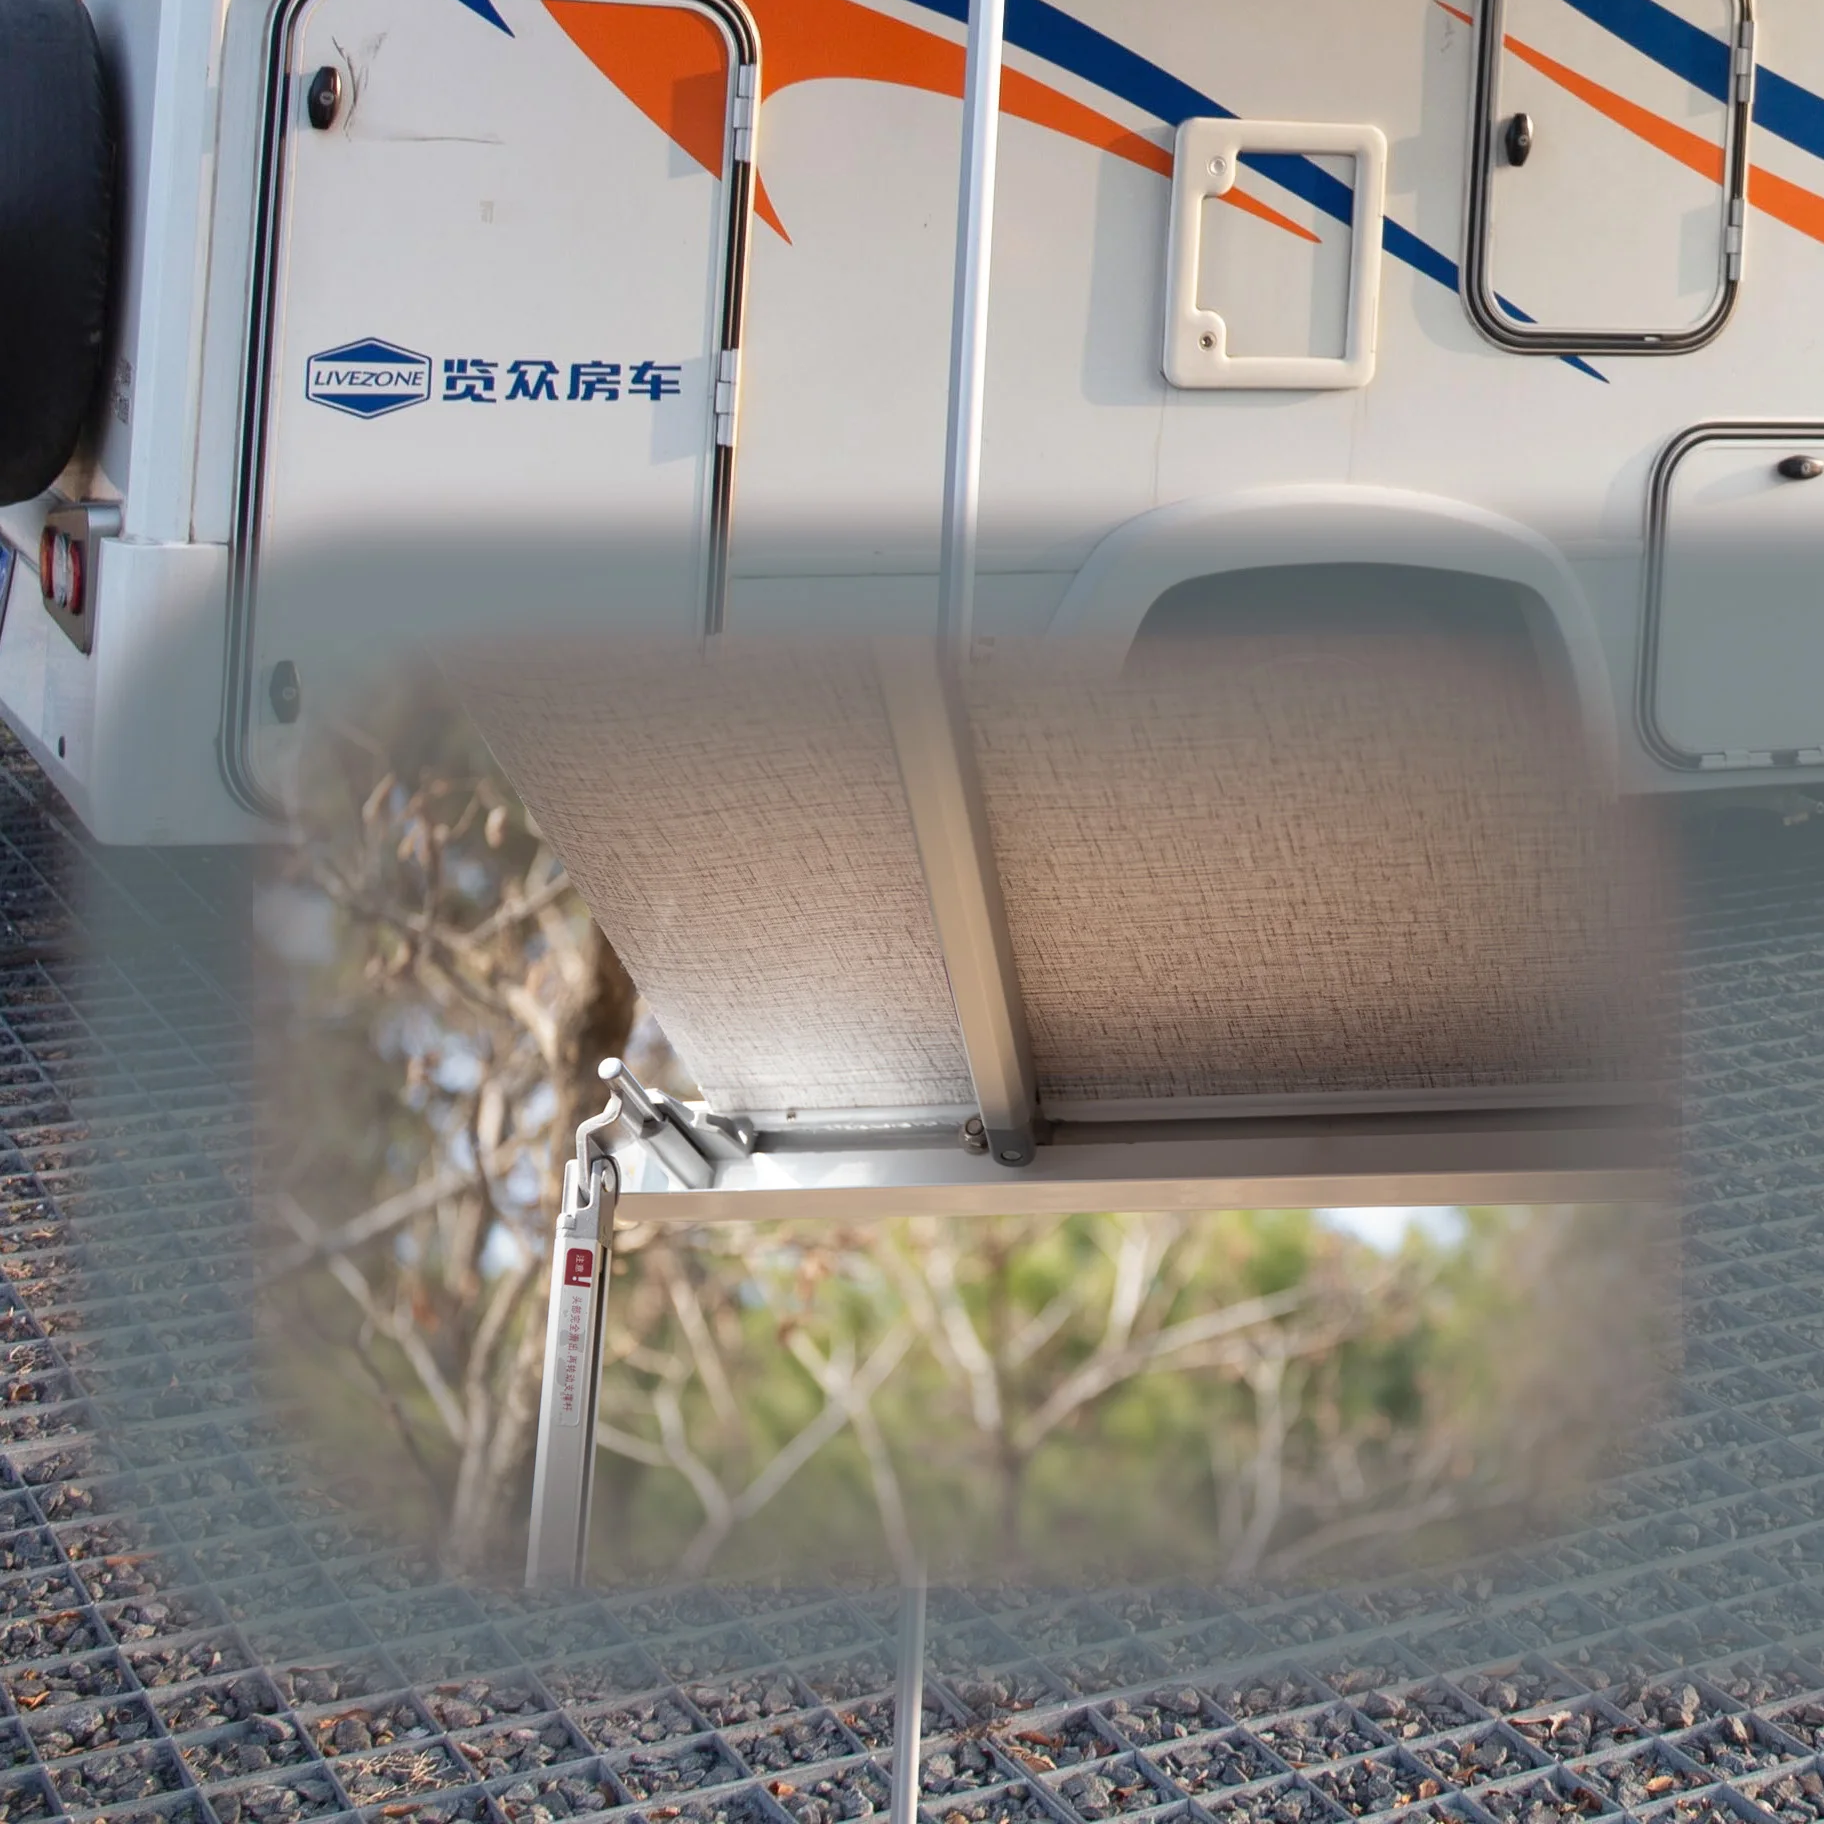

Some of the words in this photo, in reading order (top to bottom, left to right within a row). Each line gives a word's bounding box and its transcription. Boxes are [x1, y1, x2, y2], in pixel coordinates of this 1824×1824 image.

[314, 369, 424, 388] LIVEZONE
[443, 358, 683, 403] 览众房车
